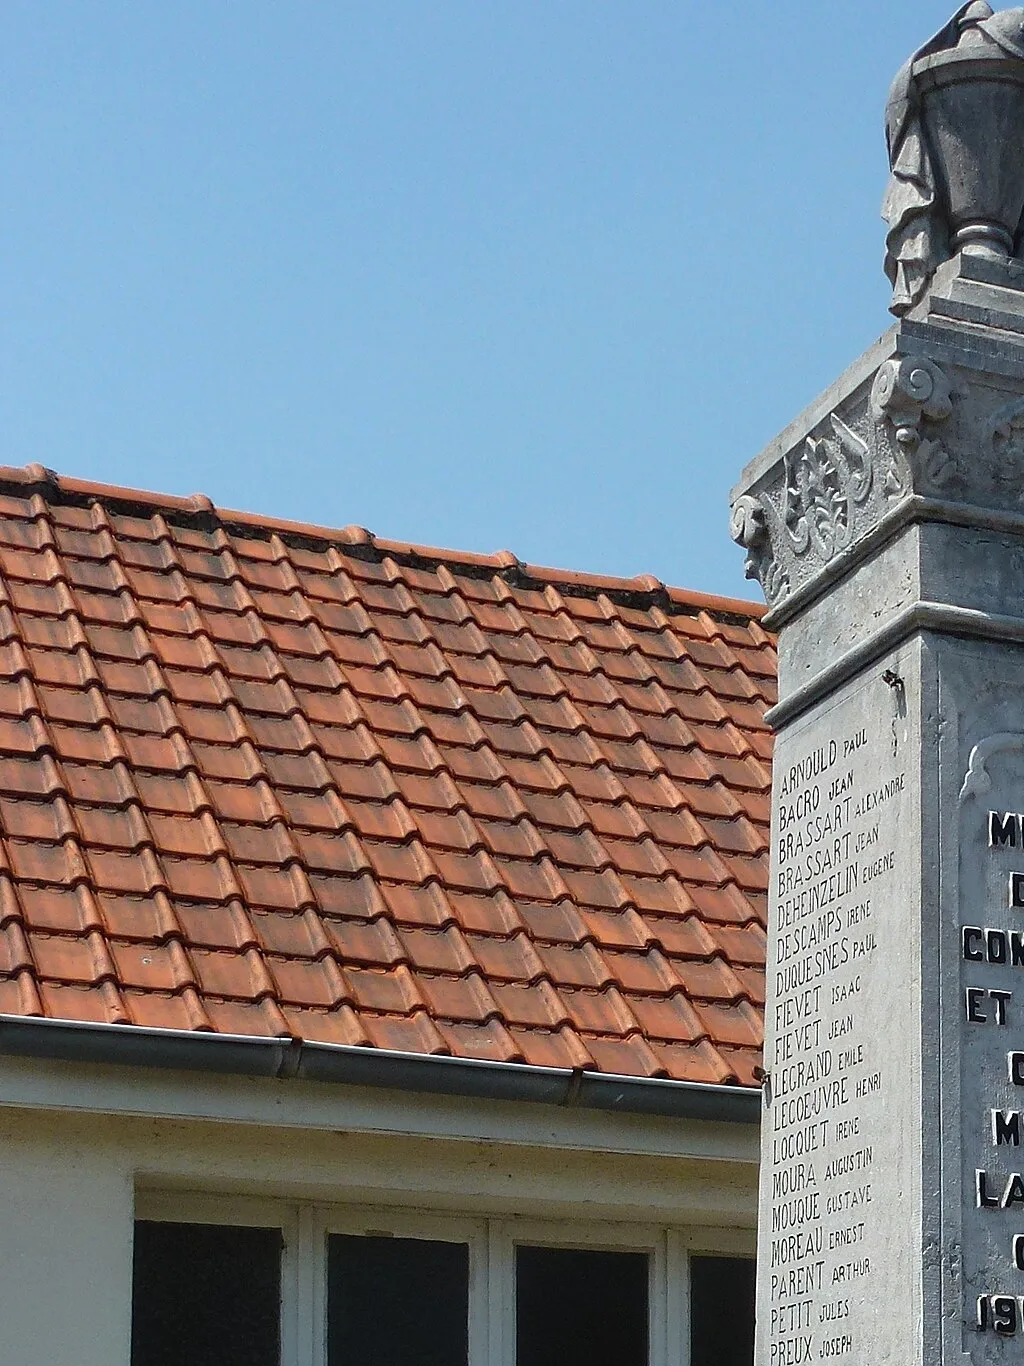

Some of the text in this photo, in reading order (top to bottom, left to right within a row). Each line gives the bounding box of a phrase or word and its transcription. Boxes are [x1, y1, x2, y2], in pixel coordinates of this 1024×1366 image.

[780, 729, 868, 799] ARNOULD PAUL
[779, 773, 905, 864] BRASSART ALEXANDRE
[780, 770, 854, 832] BACRO JEAN
[778, 824, 879, 898] BRASSART JEAN
[778, 851, 895, 932] DEHEINZELIN EUGENE
[777, 900, 871, 964] DESCAMPS IRENE
[776, 934, 877, 998] DUQUESNES PAUL
[776, 976, 860, 1031] FIEVET ISAAC
[965, 987, 1011, 1027] ET
[775, 1014, 854, 1065] FIEVET JEAN
[774, 1044, 864, 1098] LEGRAND EMILE
[774, 1072, 881, 1132] LECOEUVRE HENRI
[774, 1117, 860, 1165] LOCQUET IRENE
[772, 1146, 872, 1200] MOURA AUGUSTIN
[772, 1184, 872, 1232] MOUQUE GUSTAVE
[771, 1223, 865, 1268] MOREAU ERNEST
[771, 1258, 870, 1302] PARENT ARTHUR
[770, 1300, 849, 1336] PETIT JULES
[820, 1336, 852, 1358] JOSEPH
